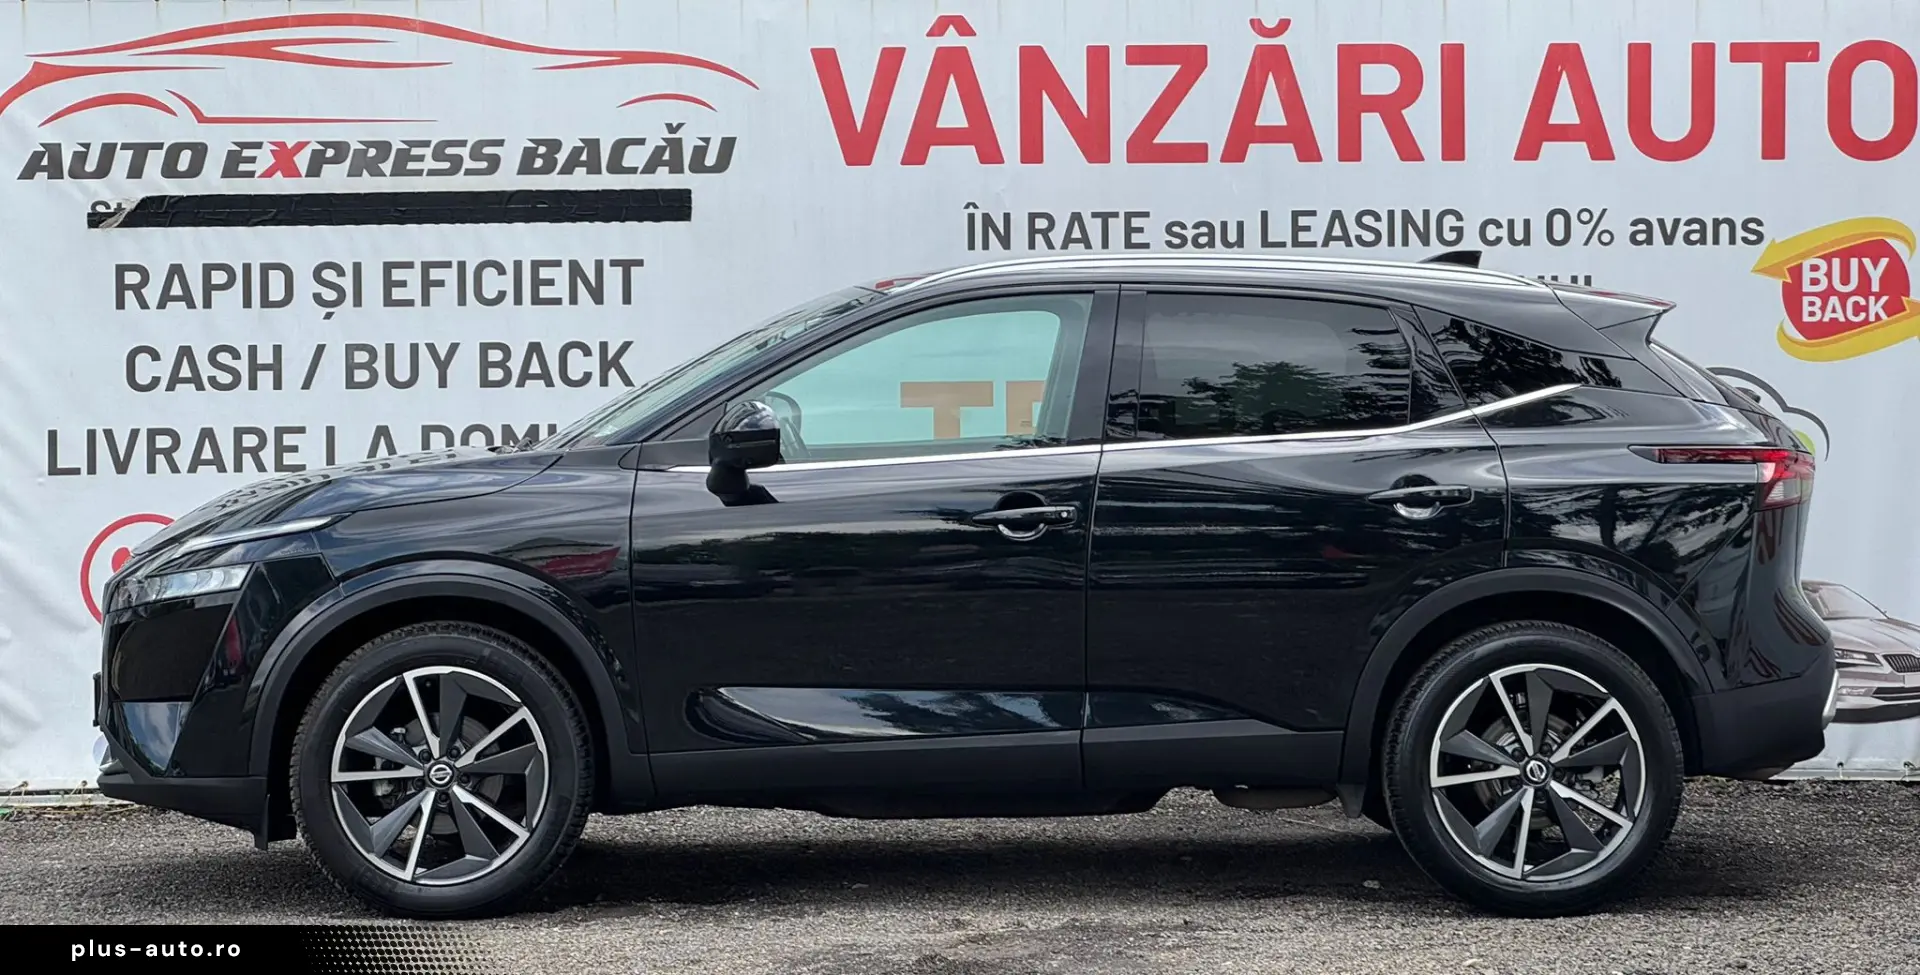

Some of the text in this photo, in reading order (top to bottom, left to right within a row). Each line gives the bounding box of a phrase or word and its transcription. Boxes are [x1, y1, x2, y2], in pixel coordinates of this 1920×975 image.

[811, 14, 1919, 167] VÂNZĂRI AUTO
[16, 121, 737, 181] AUTO EXPRESS BACĂU
[964, 201, 1765, 251] ÎN RATE sau LEASING cu 0% avans
[115, 258, 645, 321] RAPID ȘI EFICIENT
[1801, 257, 1889, 293] BUY
[1801, 295, 1889, 322] BACK
[126, 340, 636, 393] CASH / BUY BACK
[47, 425, 307, 476] LIVRARE
